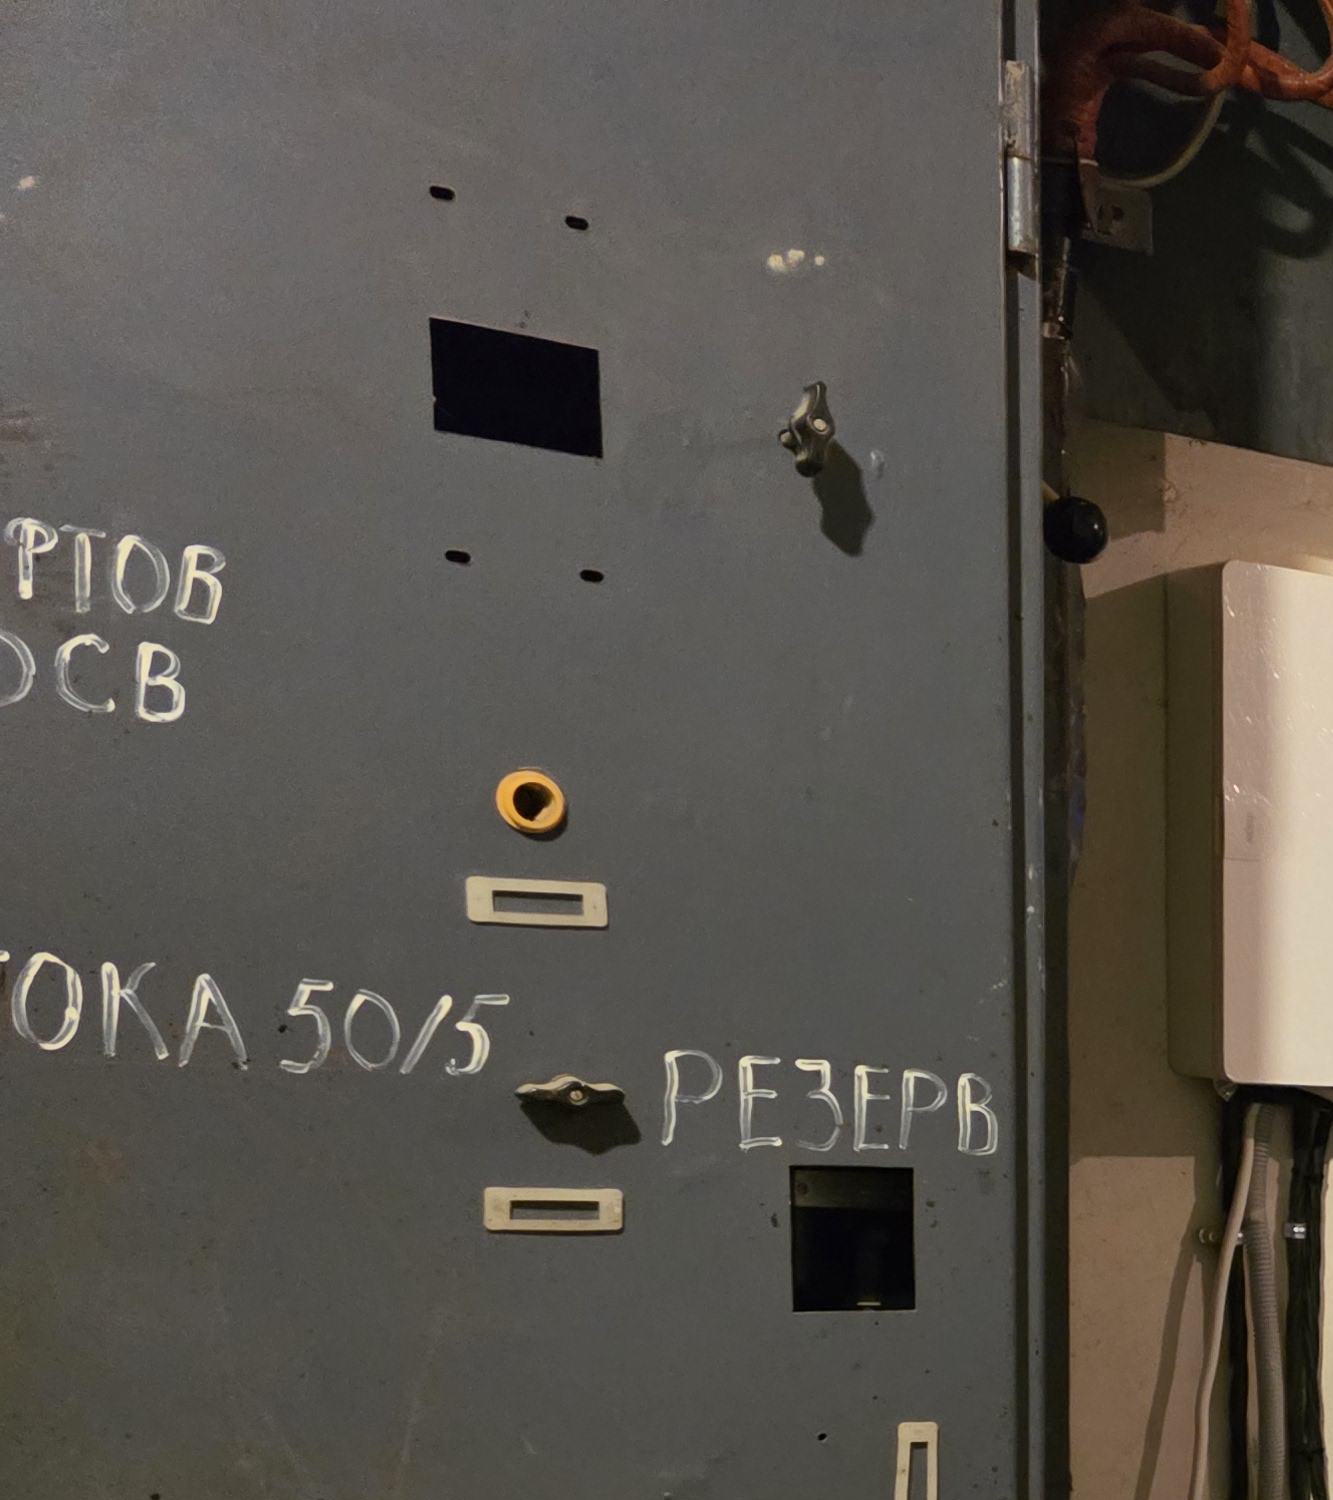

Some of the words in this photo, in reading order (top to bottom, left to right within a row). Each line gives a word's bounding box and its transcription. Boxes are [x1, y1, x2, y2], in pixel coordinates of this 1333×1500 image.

[0, 951, 248, 1070] ОКА
[281, 979, 511, 1076] 50/5
[662, 1049, 1000, 1157] РЕЗЕРВ
